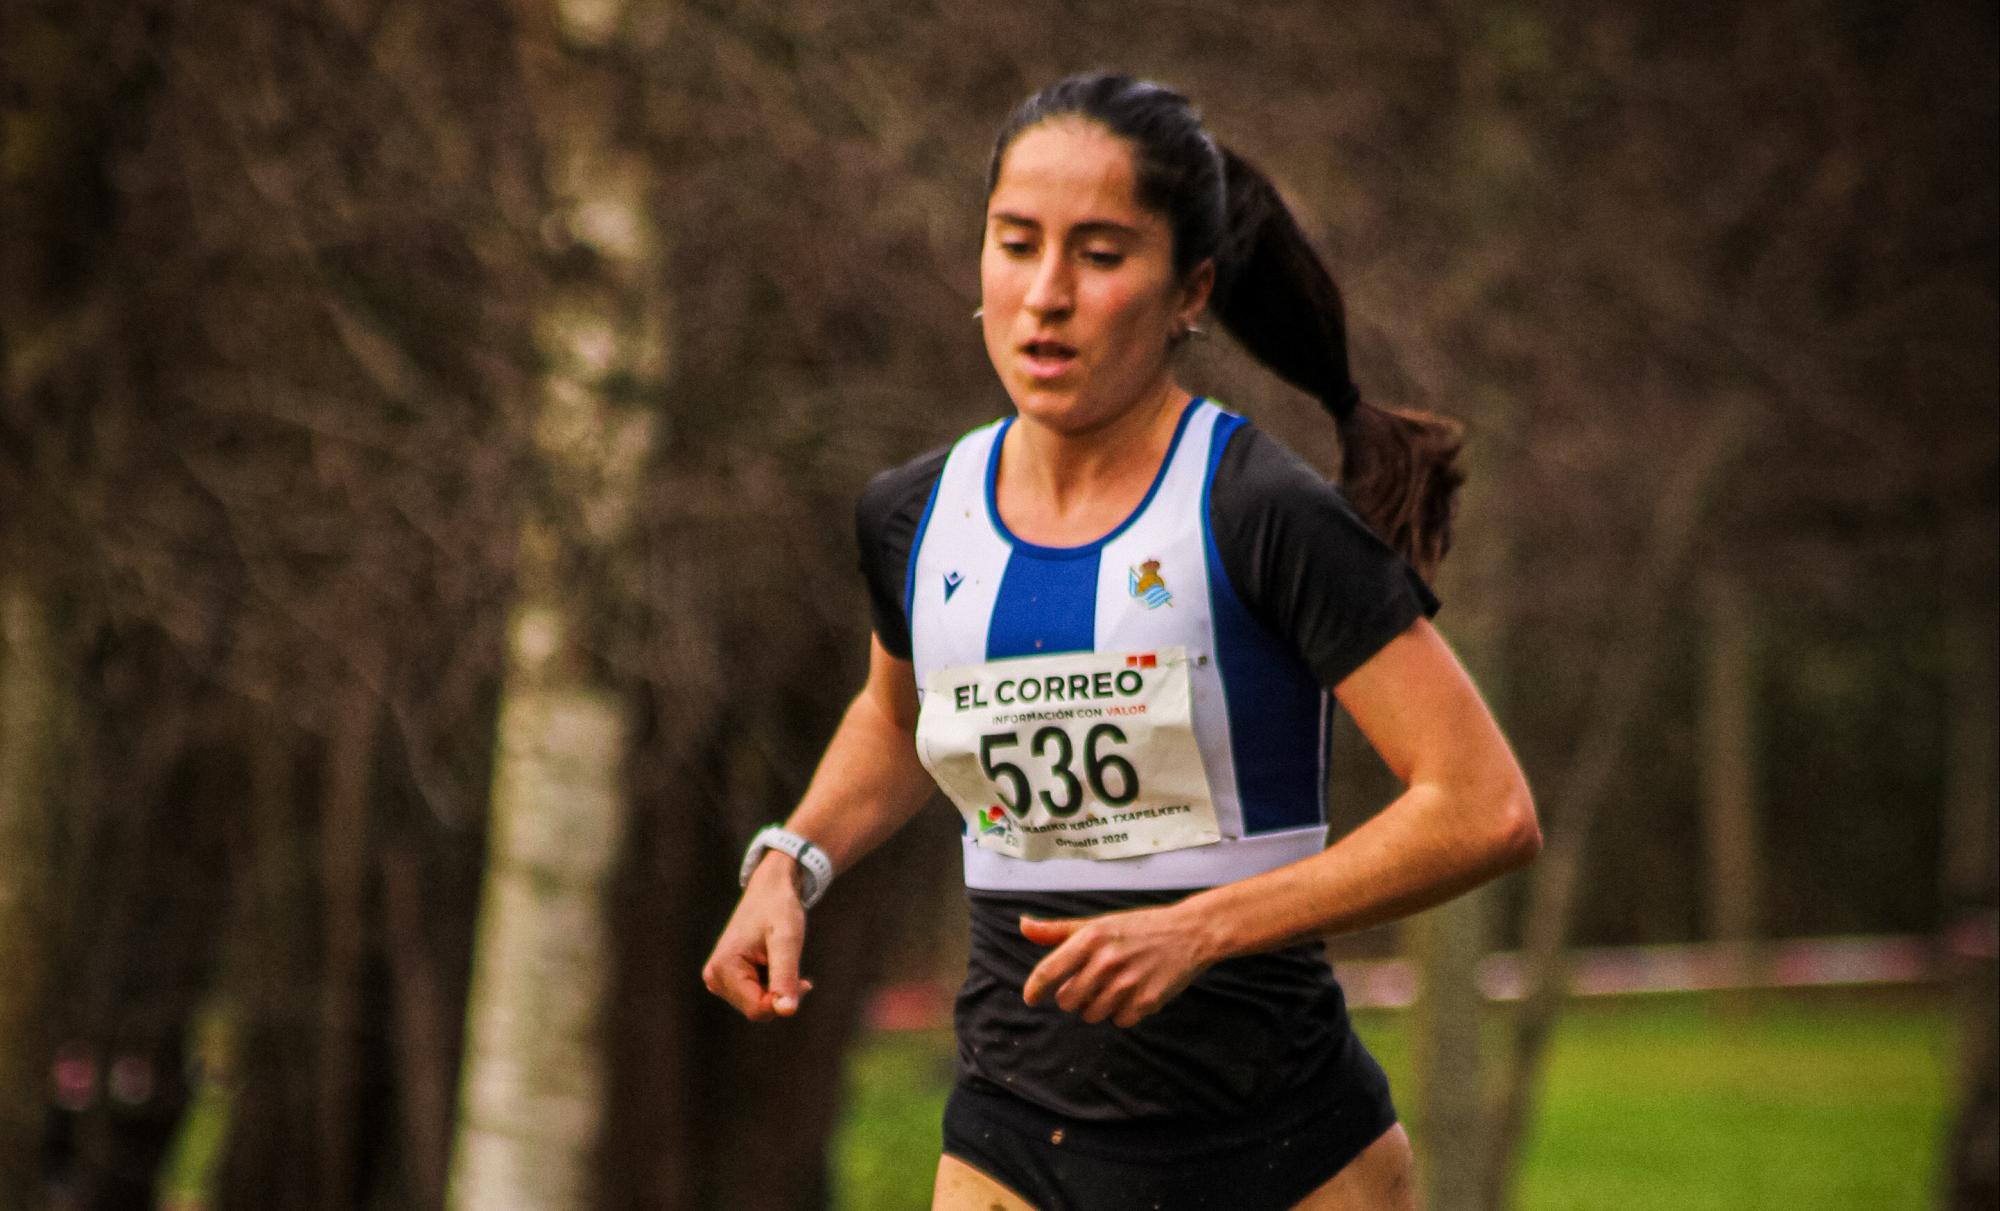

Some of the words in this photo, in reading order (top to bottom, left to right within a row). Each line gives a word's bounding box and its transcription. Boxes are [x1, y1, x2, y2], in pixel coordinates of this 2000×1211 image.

[955, 684, 987, 711] EL
[995, 670, 1143, 705] CORREO
[993, 710, 1073, 725] INFORMACIÓN
[1077, 708, 1103, 719] CON
[1106, 704, 1147, 716] VALOR
[980, 723, 1140, 819] 536
[1113, 805, 1191, 823] TXAPELKETA
